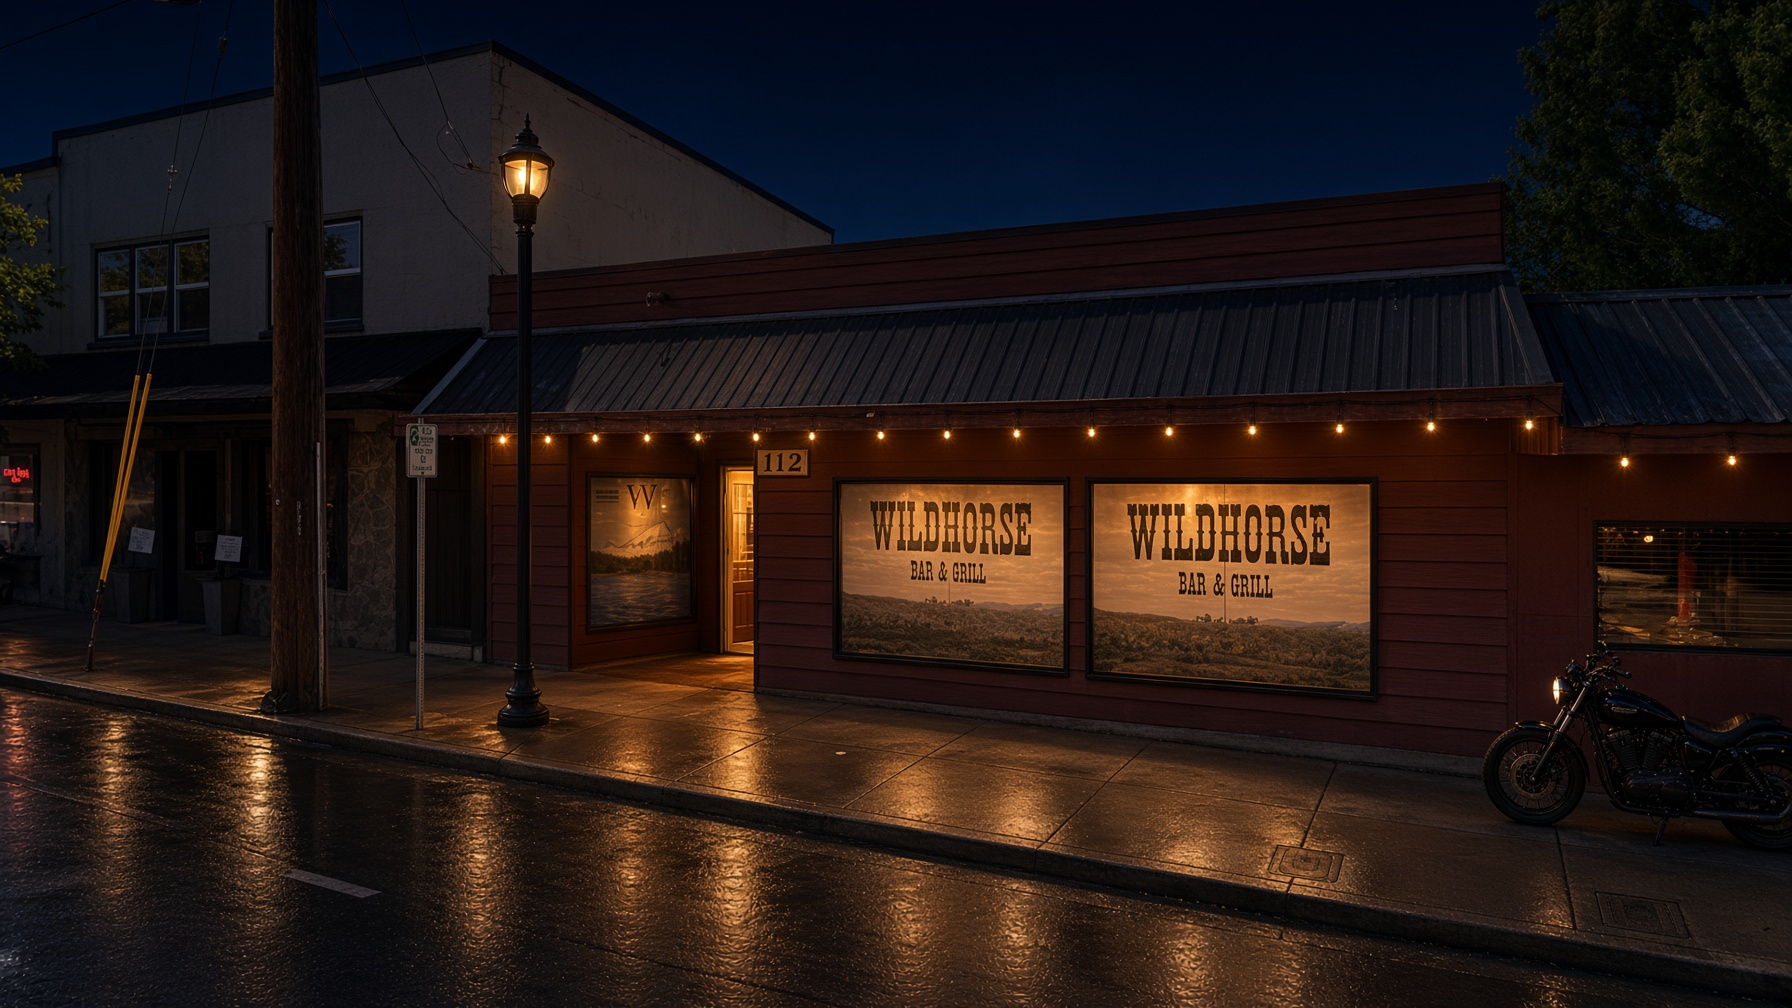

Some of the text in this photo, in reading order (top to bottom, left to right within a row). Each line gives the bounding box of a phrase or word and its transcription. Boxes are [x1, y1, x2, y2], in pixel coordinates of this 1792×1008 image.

[763, 452, 802, 472] 112
[626, 484, 658, 510] W
[870, 500, 1032, 556] WILDHORSE
[1127, 503, 1331, 566] WILDHORSE
[910, 560, 987, 584] BAR & GRILL
[1178, 571, 1273, 599] BAR & GRILL
